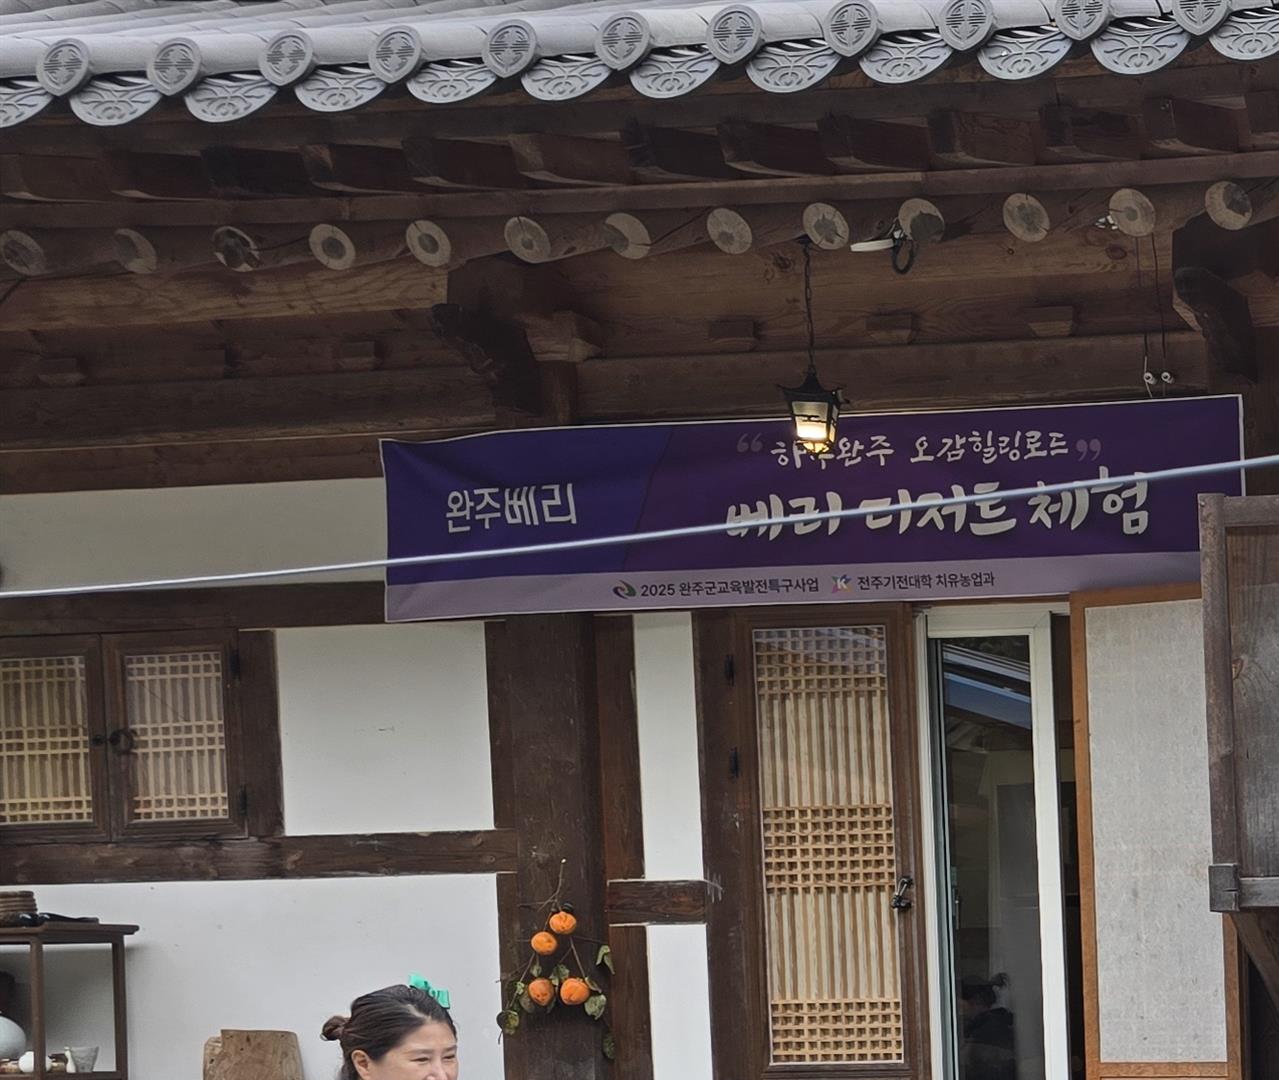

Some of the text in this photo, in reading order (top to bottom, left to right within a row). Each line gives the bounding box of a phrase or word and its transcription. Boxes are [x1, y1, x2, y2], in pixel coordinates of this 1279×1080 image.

[445, 483, 577, 533] 완주베리
[726, 466, 1150, 541] 베리 디저트 체험
[641, 583, 676, 597] 2025
[857, 571, 995, 591] 전주기전대학 치유농업과
